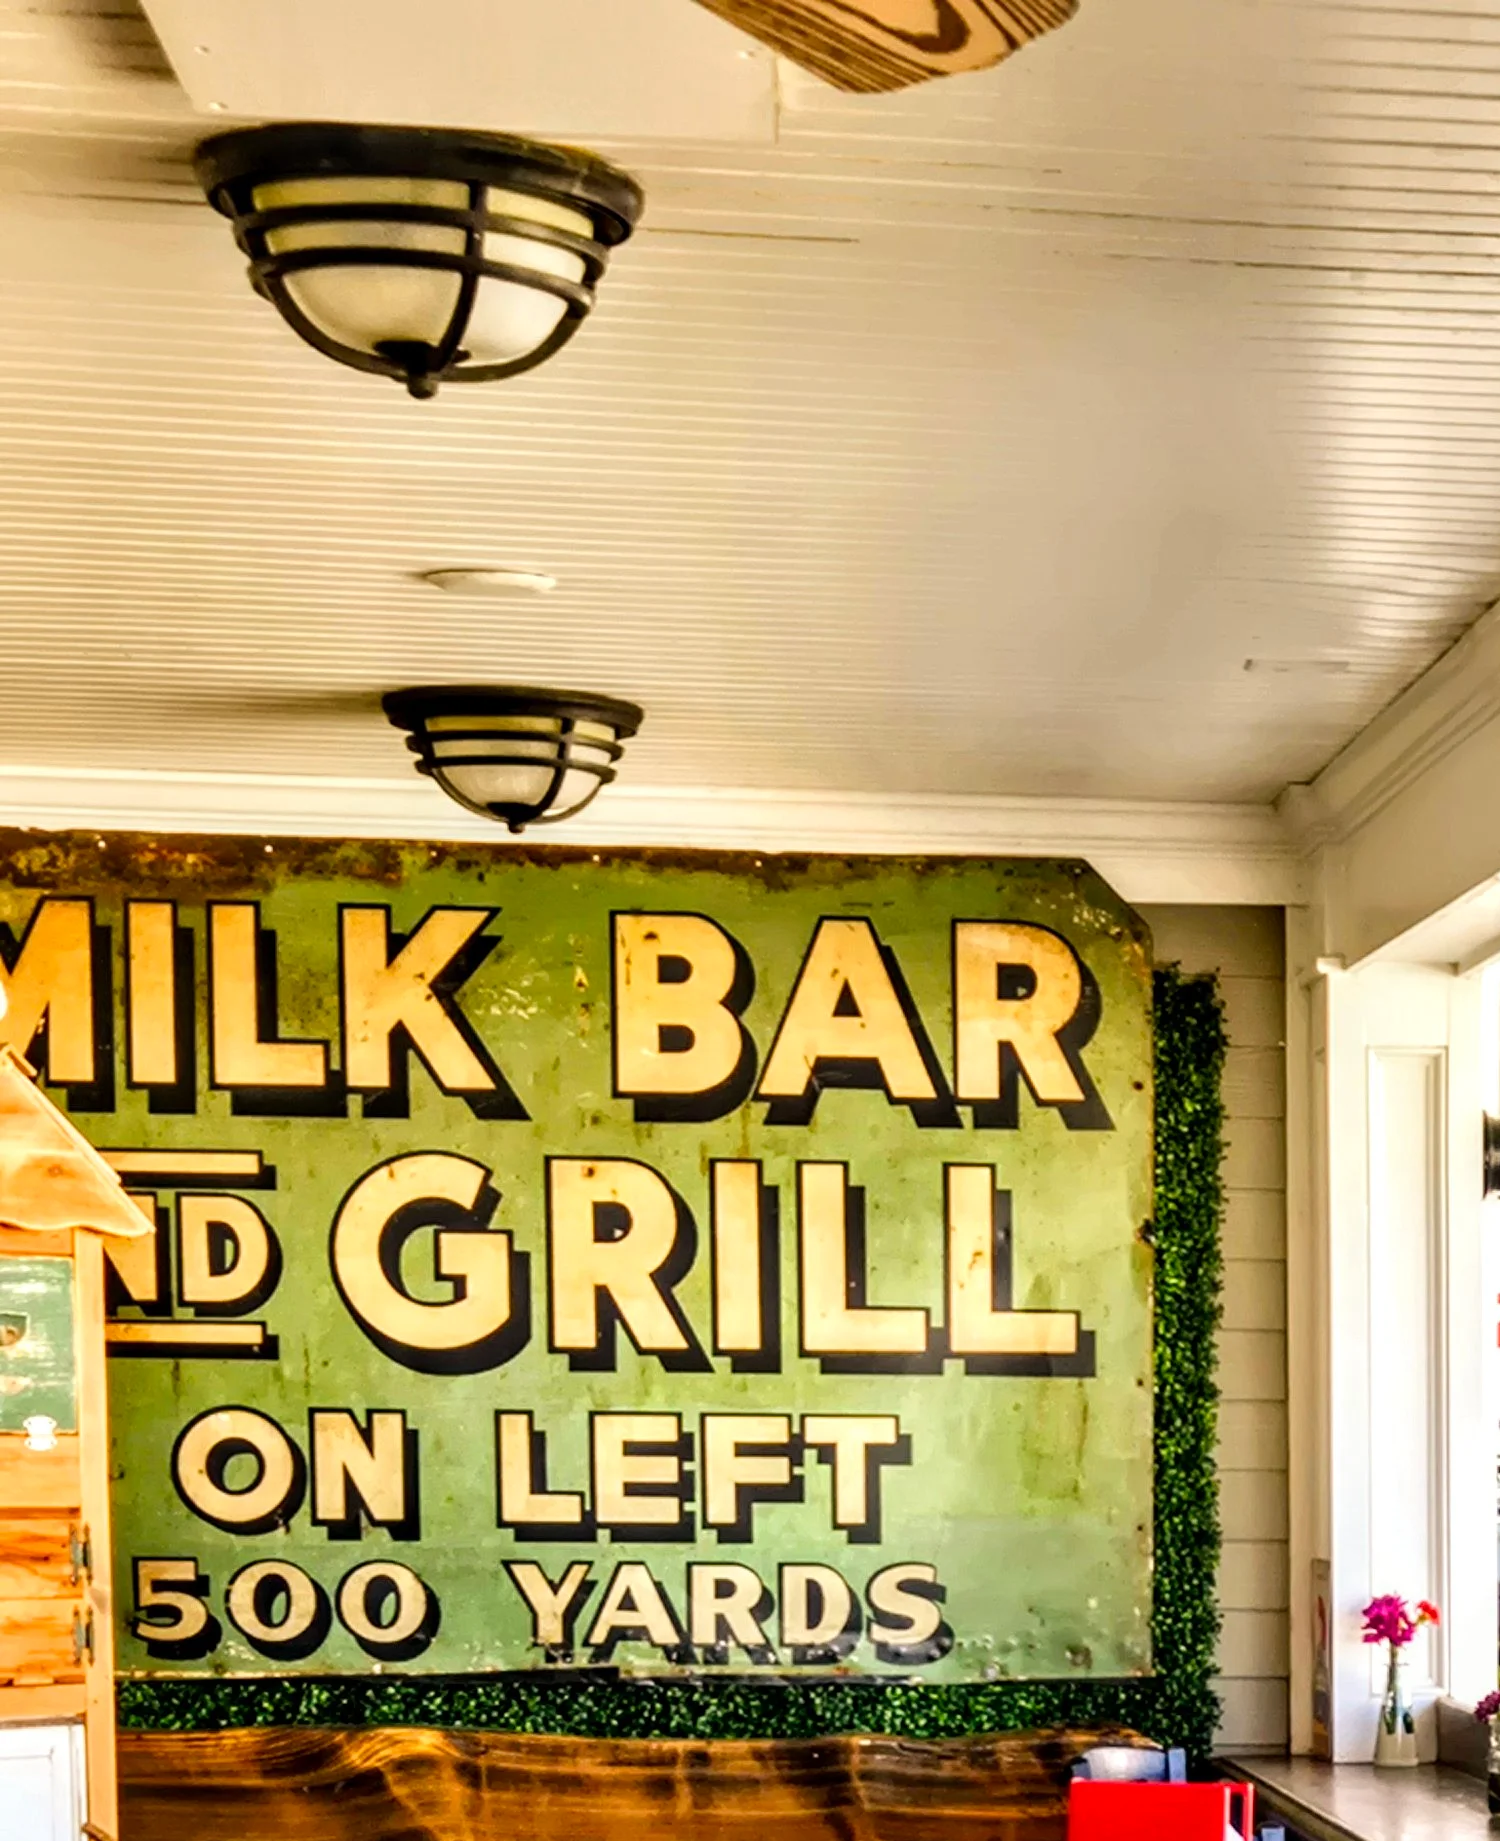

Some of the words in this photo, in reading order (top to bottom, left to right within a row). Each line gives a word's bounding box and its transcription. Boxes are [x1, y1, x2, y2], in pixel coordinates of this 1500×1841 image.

[0, 895, 530, 1120] MILK
[610, 909, 1116, 1129] BAR
[330, 1150, 1096, 1377] GRILL
[171, 1405, 420, 1541] ON
[495, 1409, 912, 1543] LEFT
[131, 1557, 441, 1661] 500
[503, 1560, 955, 1666] YARDS
